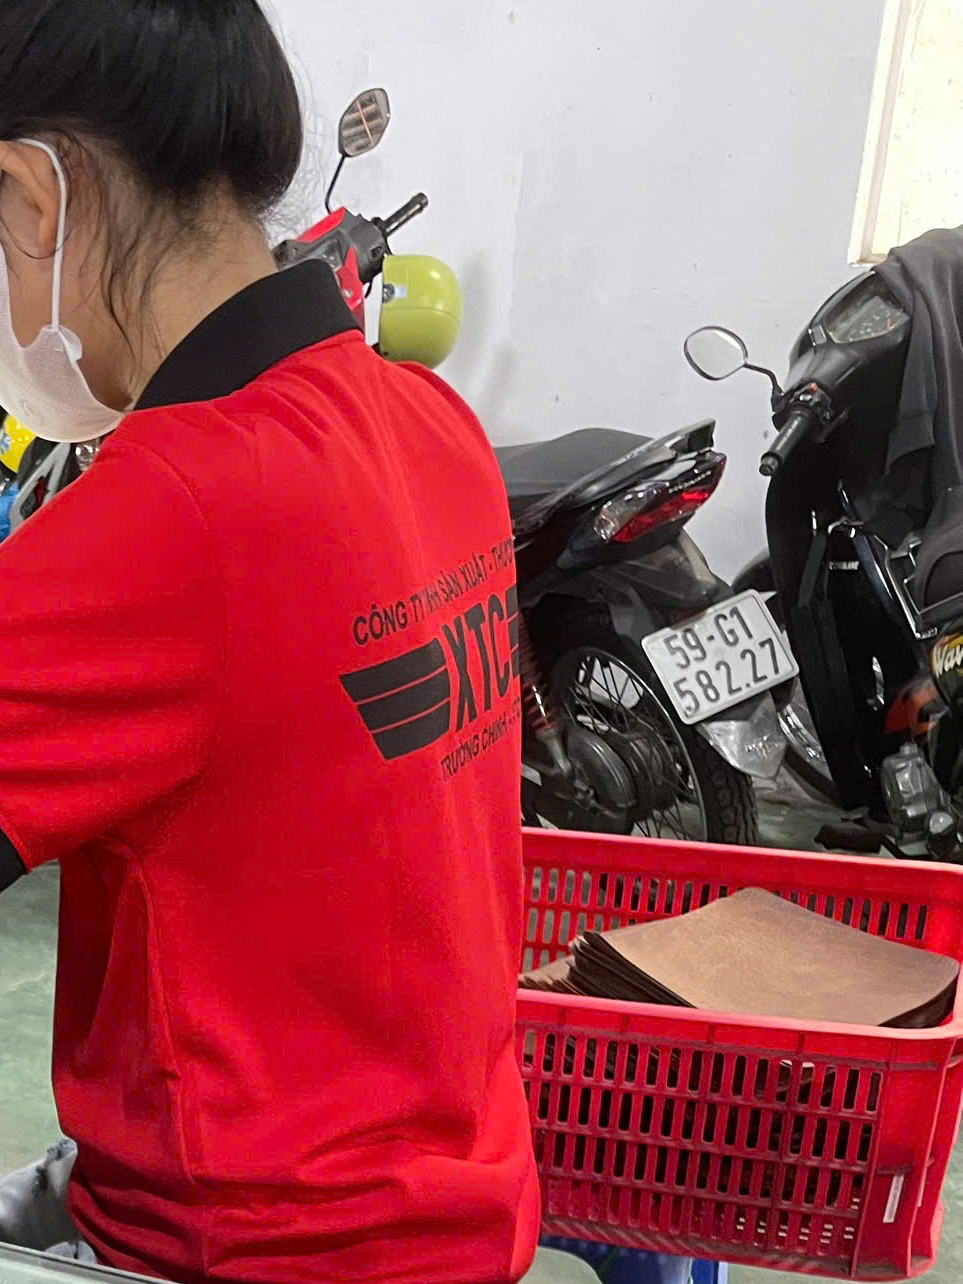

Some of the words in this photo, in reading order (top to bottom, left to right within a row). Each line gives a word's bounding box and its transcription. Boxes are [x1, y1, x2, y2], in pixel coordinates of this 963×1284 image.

[353, 601, 408, 646] CÔNG
[663, 606, 753, 670] 59-G1
[441, 594, 510, 733] XTC
[673, 637, 780, 715] 582.27
